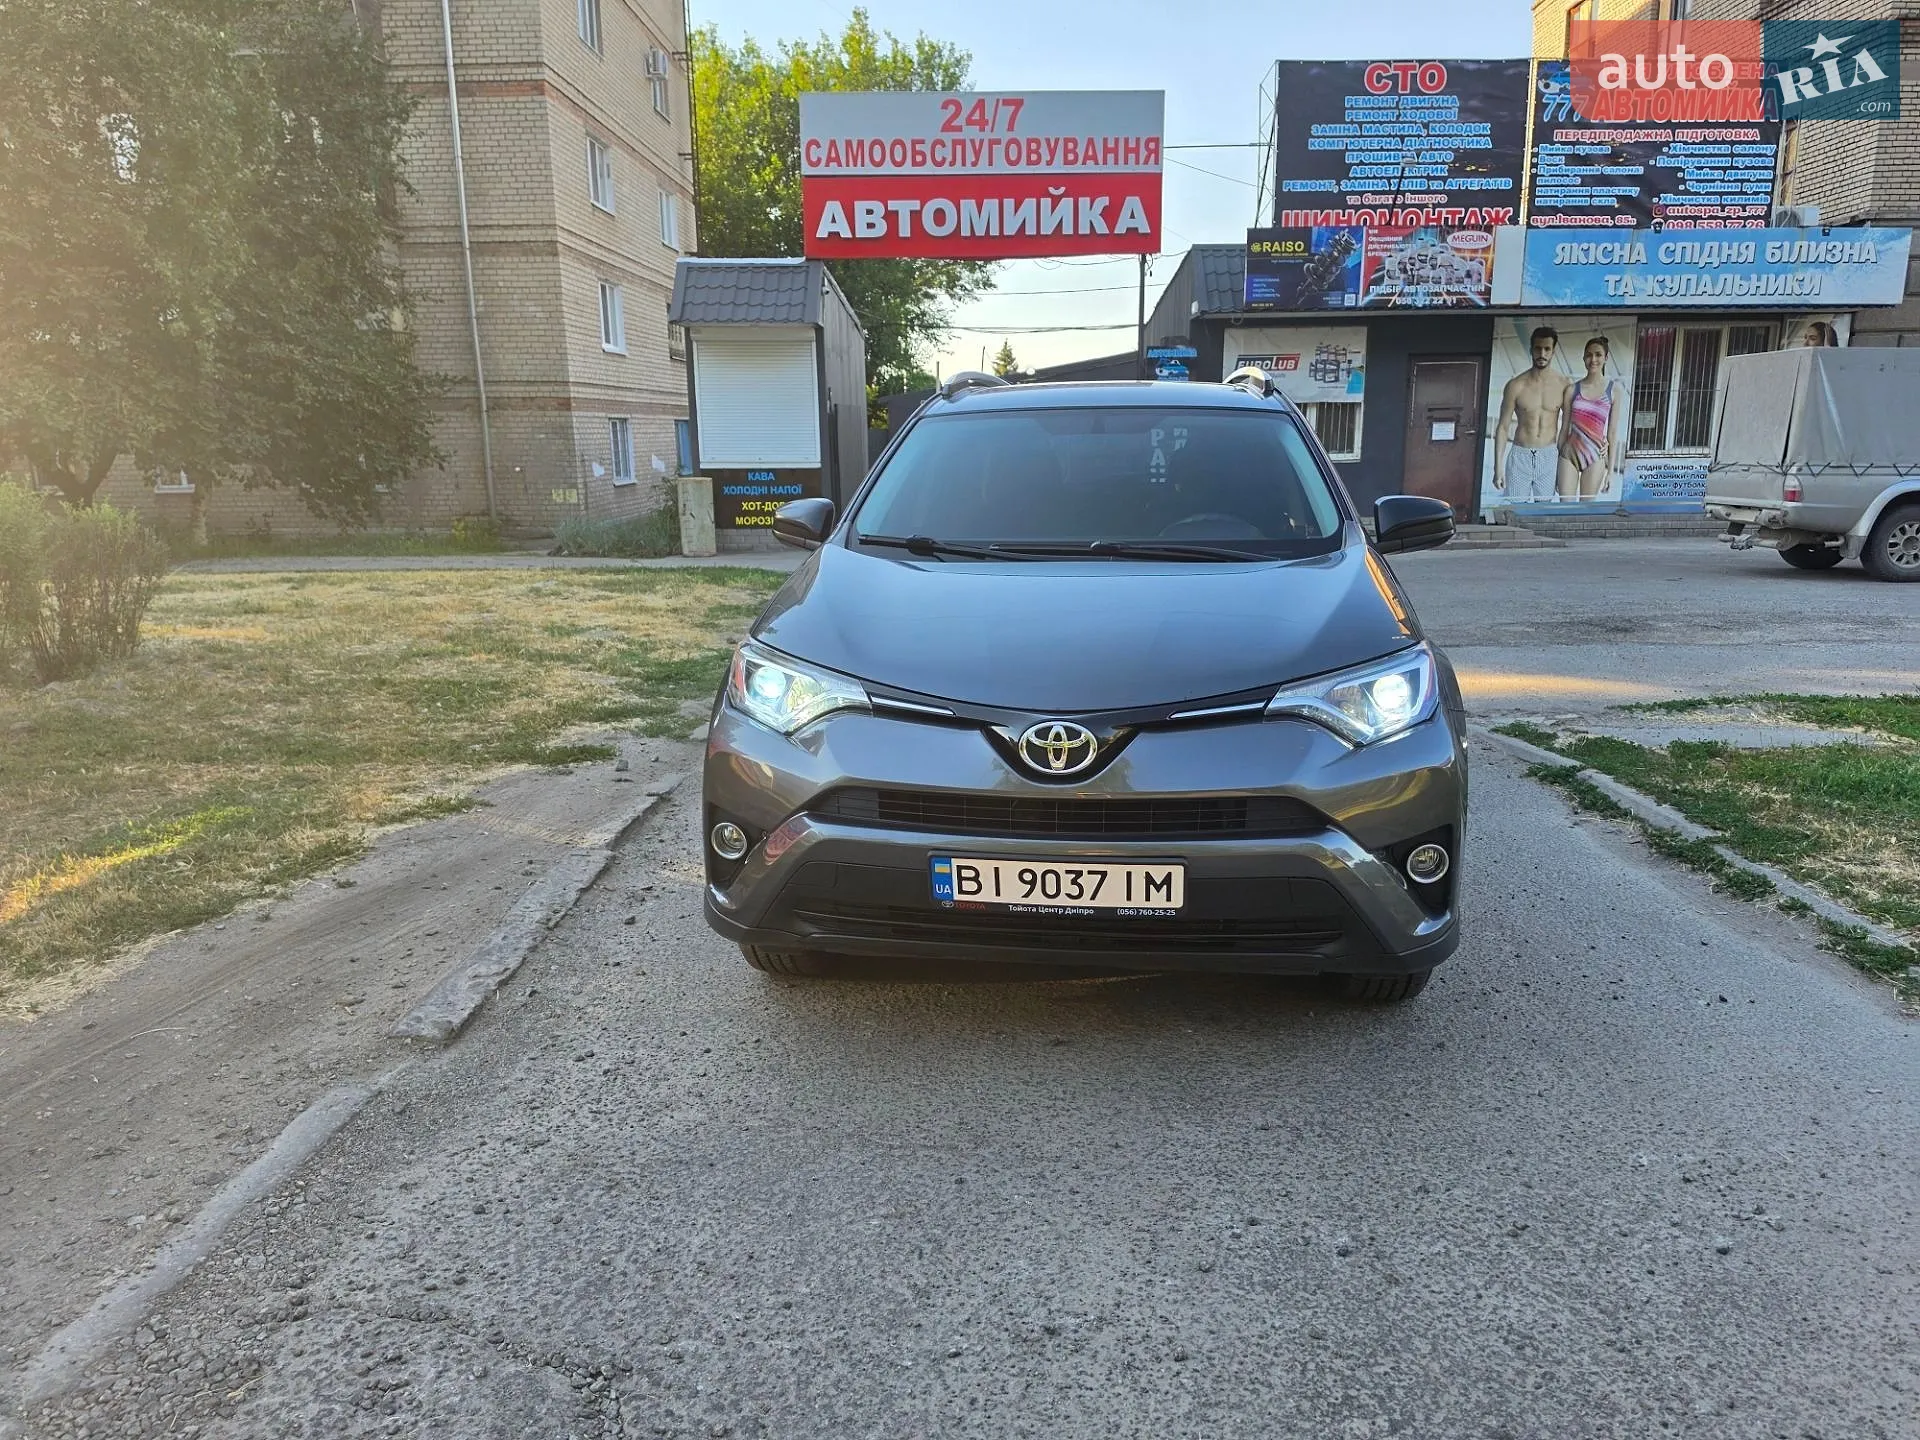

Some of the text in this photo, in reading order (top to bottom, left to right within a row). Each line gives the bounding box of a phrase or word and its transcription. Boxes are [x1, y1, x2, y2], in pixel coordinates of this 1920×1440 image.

[1364, 62, 1447, 94] СТО
[1345, 96, 1459, 109] РЕМОНТ ДВИГУНА
[1590, 80, 1780, 123] АВТОМИЙКА
[940, 98, 1024, 133] 24/7
[1345, 108, 1458, 122] РЕМОНТ ХОДОВОЇ
[1311, 123, 1491, 136] ЗАМІНА МАСТИЛА, КОЛОДОК
[1554, 129, 1760, 143] ПЕРЕДПРОДАЖНА ПІДГОТОВКА
[1403, 137, 1492, 150] ДІАГНОСТИКА
[1539, 144, 1611, 155] Мийка кузова
[1669, 143, 1776, 154] Хімчистка салону
[805, 136, 1160, 168] САМООБСЛУГОВУВАННЯ
[1420, 152, 1454, 163] АВТО
[1538, 154, 1565, 164] Воск
[1657, 156, 1774, 168] Полірування кузова
[1537, 165, 1601, 176] Прибирання
[1685, 168, 1773, 180] Мийка двигуна
[1340, 180, 1389, 191] ЗАМІНА
[1445, 178, 1512, 190] АГРЕГАТІВ
[1537, 177, 1581, 185] пилосос
[1536, 187, 1640, 197] натирання пластику
[1346, 195, 1361, 204] та
[1404, 193, 1447, 204] іншого
[1535, 198, 1617, 207] натирання скла
[1660, 194, 1770, 205] Хімчистка килимів
[816, 186, 1151, 238] АВТОМИЙКА
[1282, 208, 1513, 227] ШИНОМОНТАЖ
[1452, 234, 1489, 242] MEGUIN
[1262, 241, 1305, 252] RAISO
[1553, 241, 1878, 268] ЯКІСНА СПІДНЯ БІЛИЗНА
[1604, 273, 1822, 297] ТА КУПАЛЬНИКИ
[748, 472, 775, 481] КАВА
[723, 484, 802, 496] ХОЛОДНІ НАПОЇ
[1673, 481, 1705, 489] футболк
[935, 884, 951, 894] UA
[956, 865, 1172, 902] BI 9037 IM
[1038, 906, 1064, 914] Центр
[1065, 907, 1095, 915] Дніпро
[1117, 908, 1137, 916] (056)
